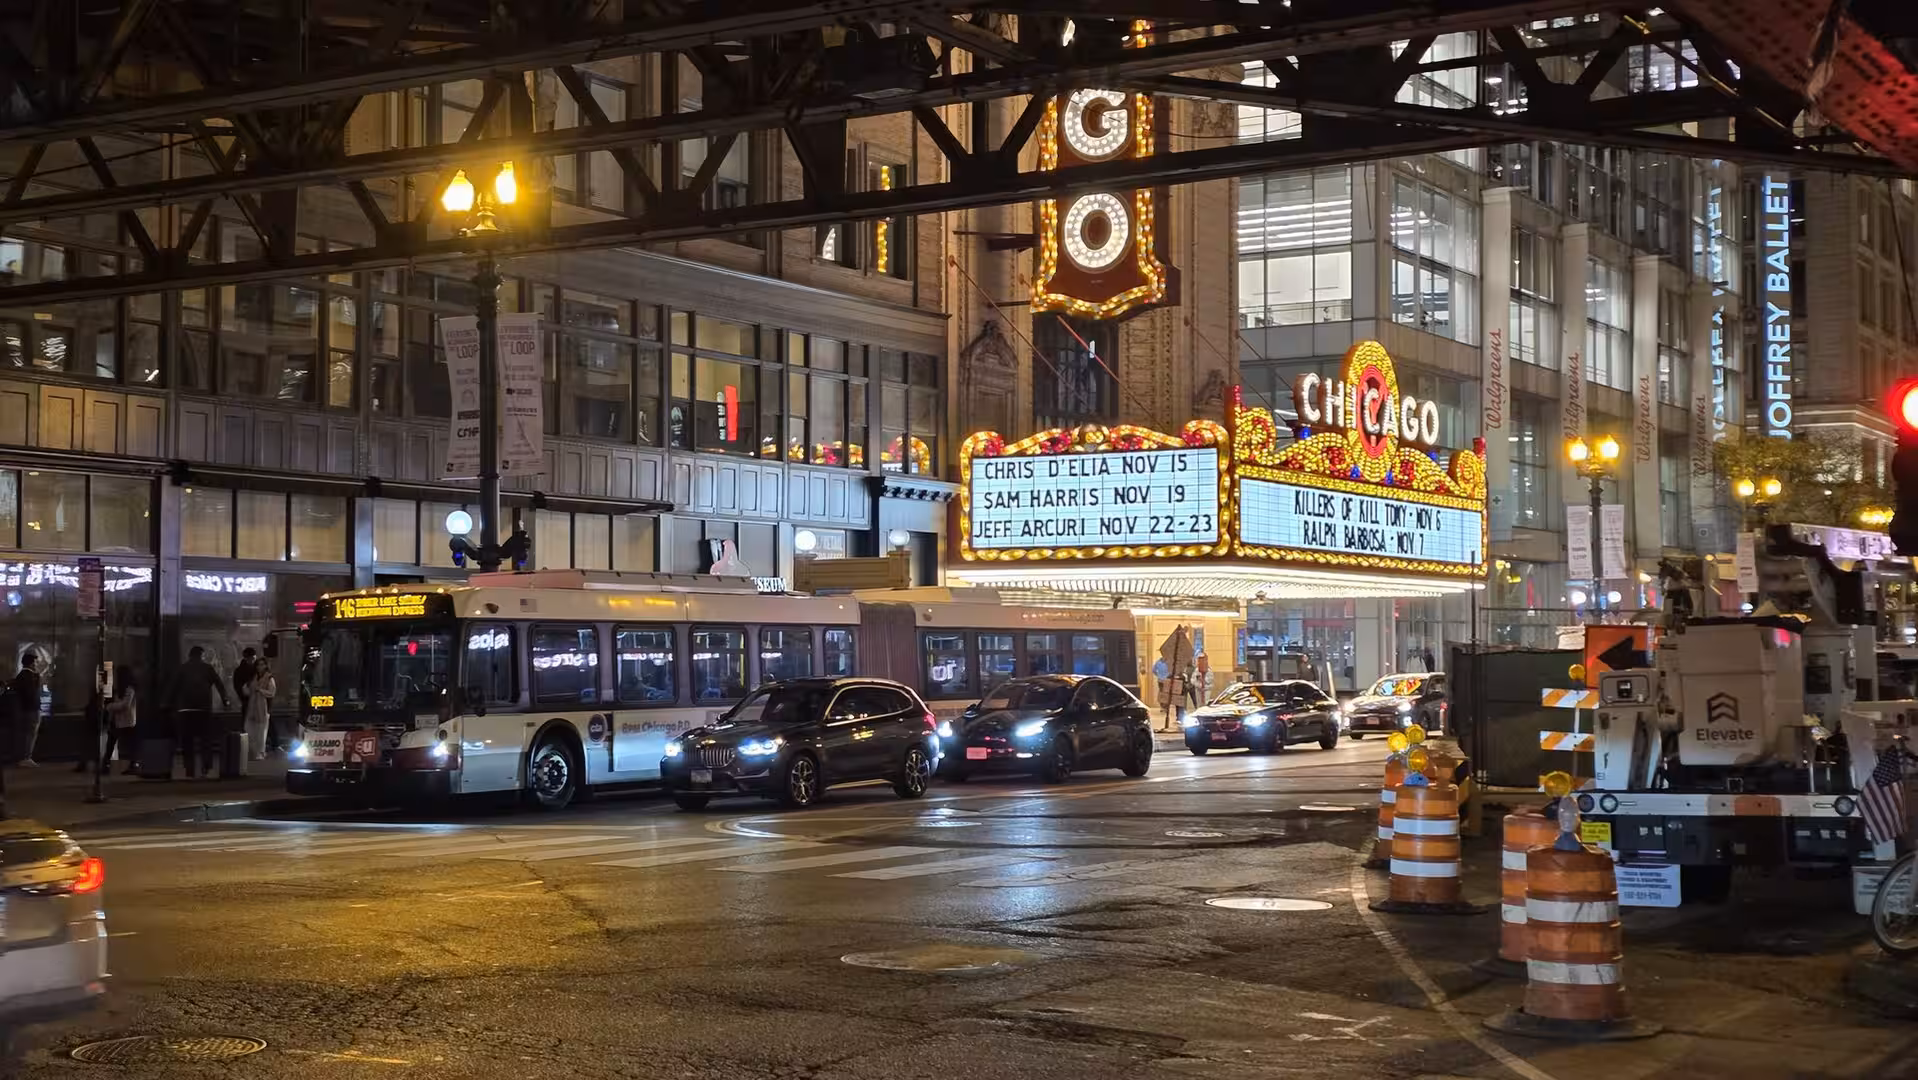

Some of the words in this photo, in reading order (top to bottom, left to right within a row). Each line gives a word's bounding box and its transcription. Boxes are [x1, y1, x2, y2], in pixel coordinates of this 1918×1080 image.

[1765, 175, 1791, 292] BALLET
[456, 344, 479, 359] LOOP
[510, 341, 535, 355] LOOP
[1485, 328, 1509, 432] Walgreens
[1767, 301, 1792, 440] JOFFREY
[1301, 372, 1440, 446] CHICAGO
[1635, 374, 1658, 465] Walgreens
[985, 460, 1034, 480] CHRIS
[1048, 457, 1111, 478] D'ELIA
[1122, 454, 1158, 474] NOV
[1170, 453, 1188, 472] 15
[983, 491, 1020, 509] SAM
[1030, 487, 1099, 507] HARRIS
[1114, 485, 1151, 504] NOV
[1167, 484, 1186, 503] 19
[1294, 489, 1336, 518] KILLERS
[1341, 498, 1353, 521] OF
[1359, 499, 1380, 524] KILL
[1415, 508, 1434, 531] NOV
[1435, 510, 1442, 531] 6
[973, 520, 1012, 539] JEFF
[1020, 517, 1086, 537] ARCURI
[1099, 515, 1138, 535] NOV
[1149, 514, 1213, 534] 22-23
[1303, 521, 1337, 548] RALPH
[1344, 525, 1387, 553] BARBOSA
[1396, 532, 1416, 555] NOV
[1419, 533, 1425, 556] 7
[751, 576, 788, 593] SEUM
[335, 599, 356, 619] 146
[1696, 728, 1754, 742] Elevate
